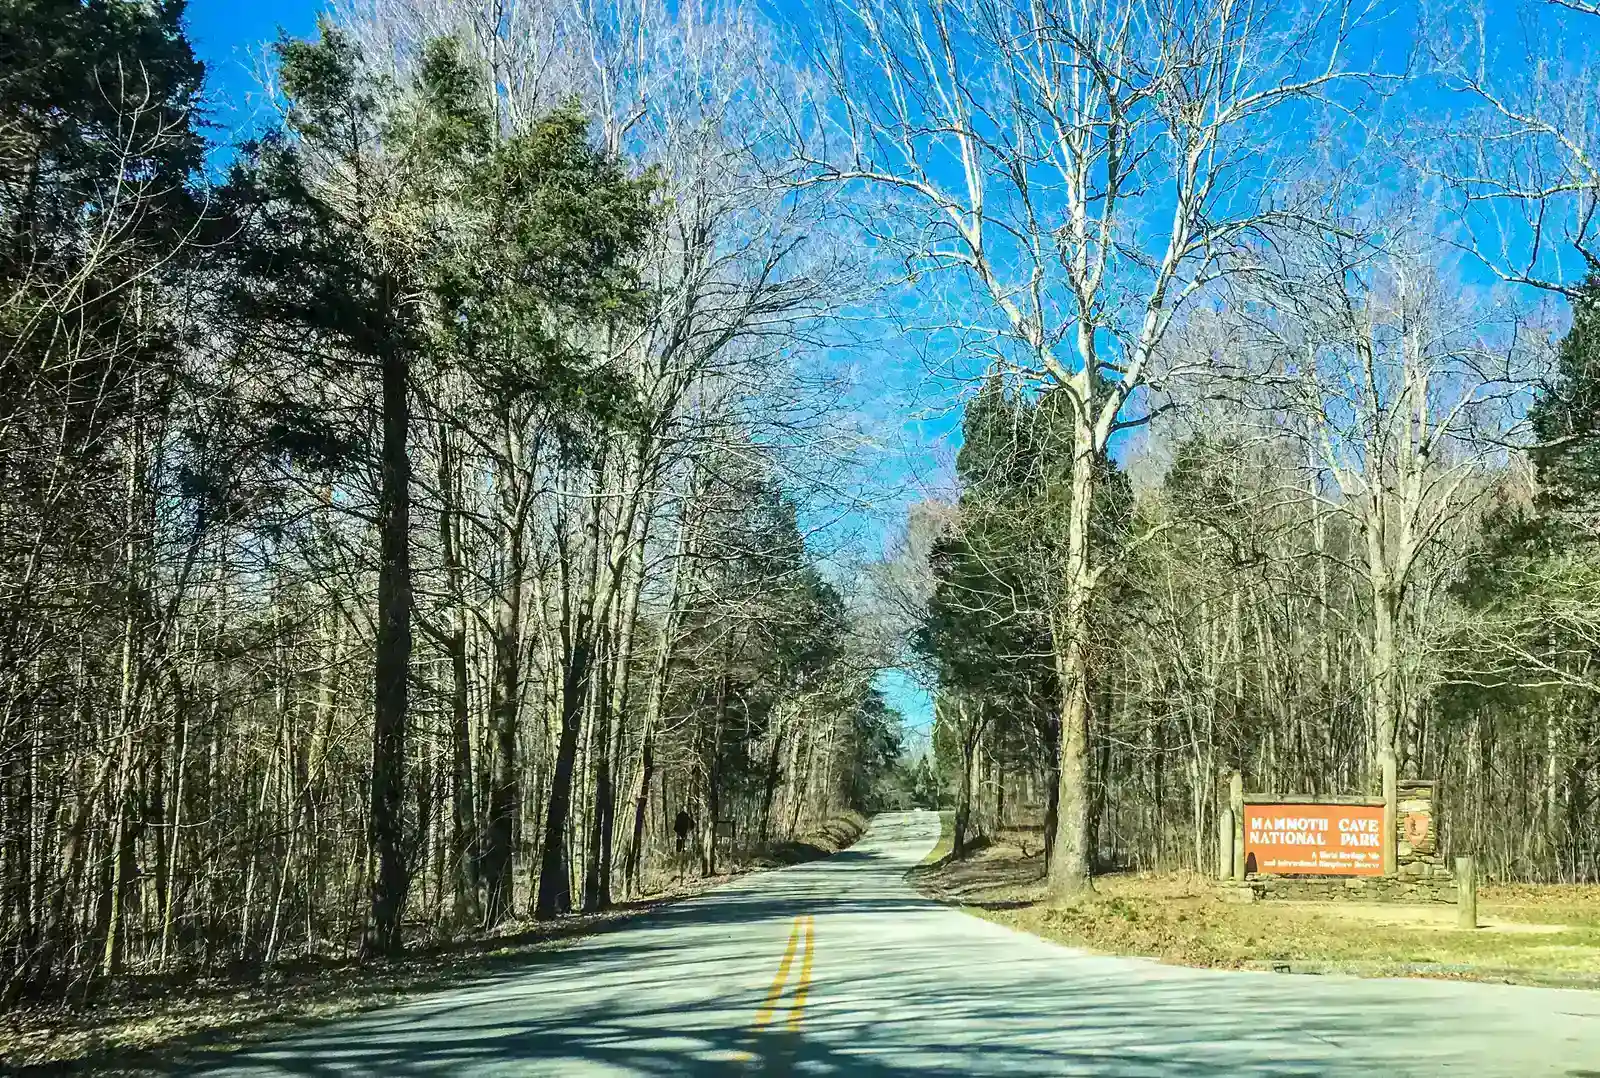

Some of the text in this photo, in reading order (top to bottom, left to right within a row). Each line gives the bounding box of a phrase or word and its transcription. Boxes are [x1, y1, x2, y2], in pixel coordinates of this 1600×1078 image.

[1251, 818, 1379, 832] MAMMOTH CAVE
[1249, 831, 1380, 846] NATIONAL PARK
